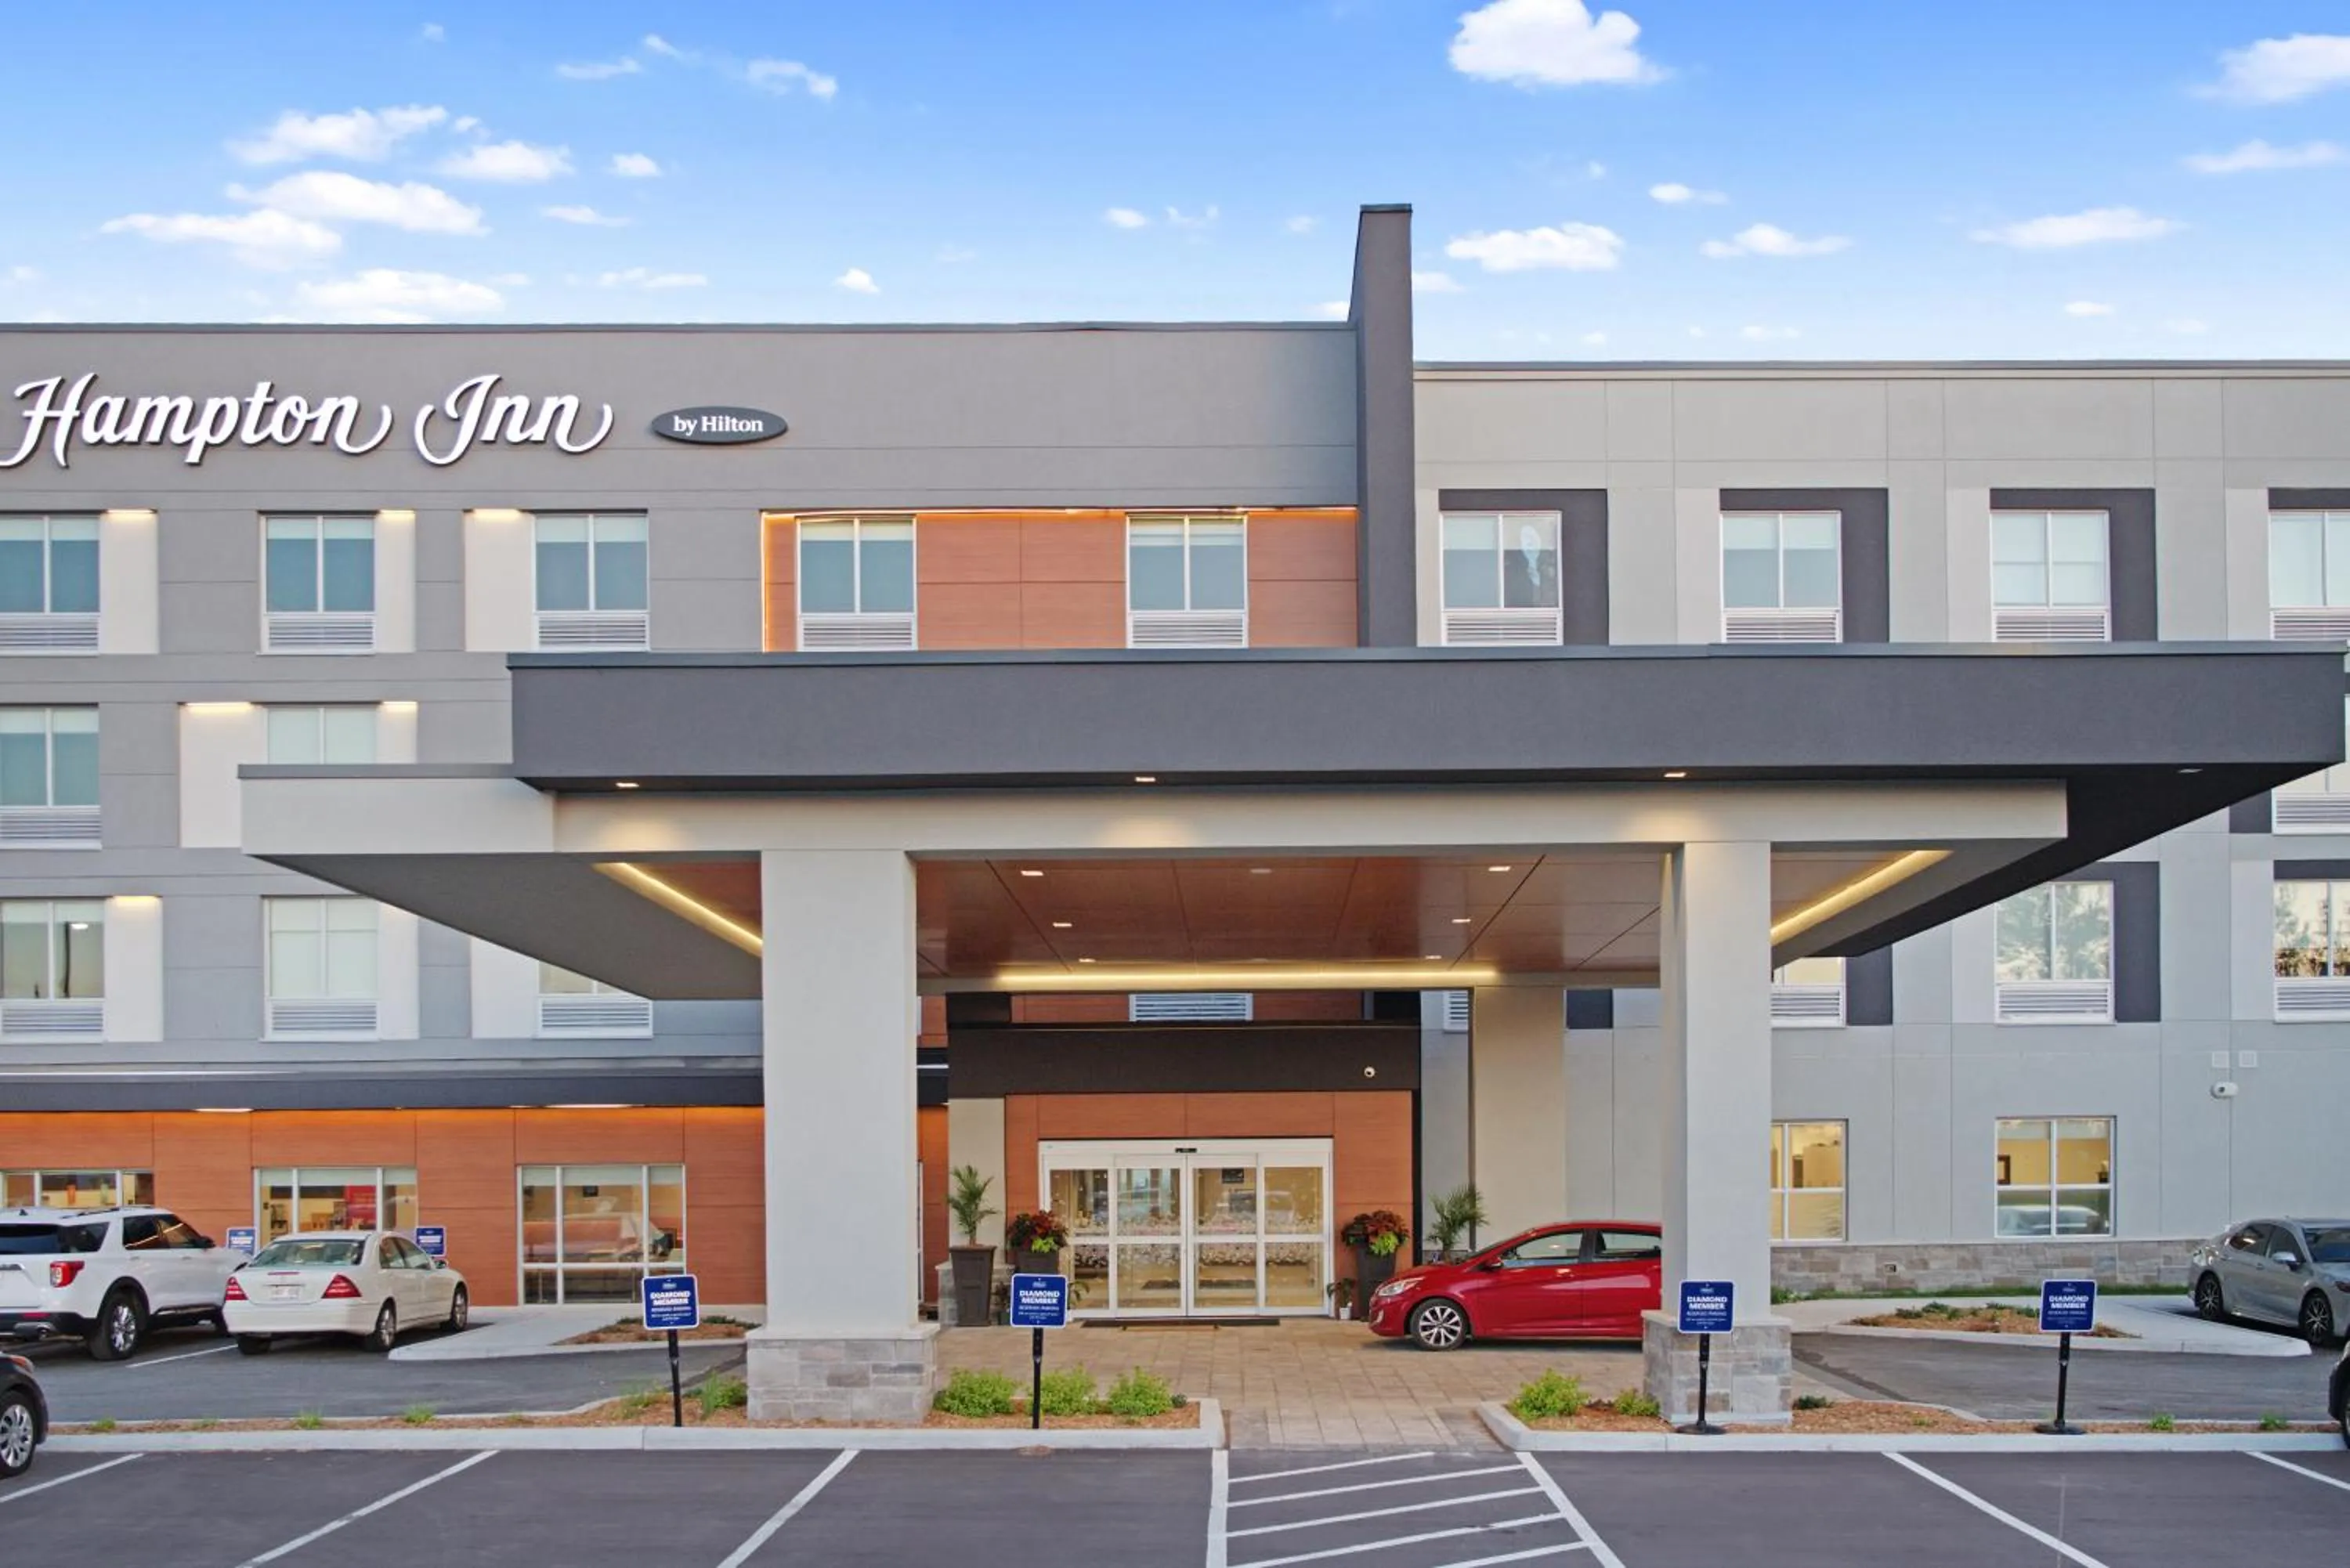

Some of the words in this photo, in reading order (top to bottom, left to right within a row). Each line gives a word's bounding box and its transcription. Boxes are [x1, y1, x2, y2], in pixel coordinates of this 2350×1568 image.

[0, 372, 391, 468] Hampton
[414, 374, 613, 465] Inn
[674, 415, 697, 435] by
[701, 416, 763, 432] Hilton
